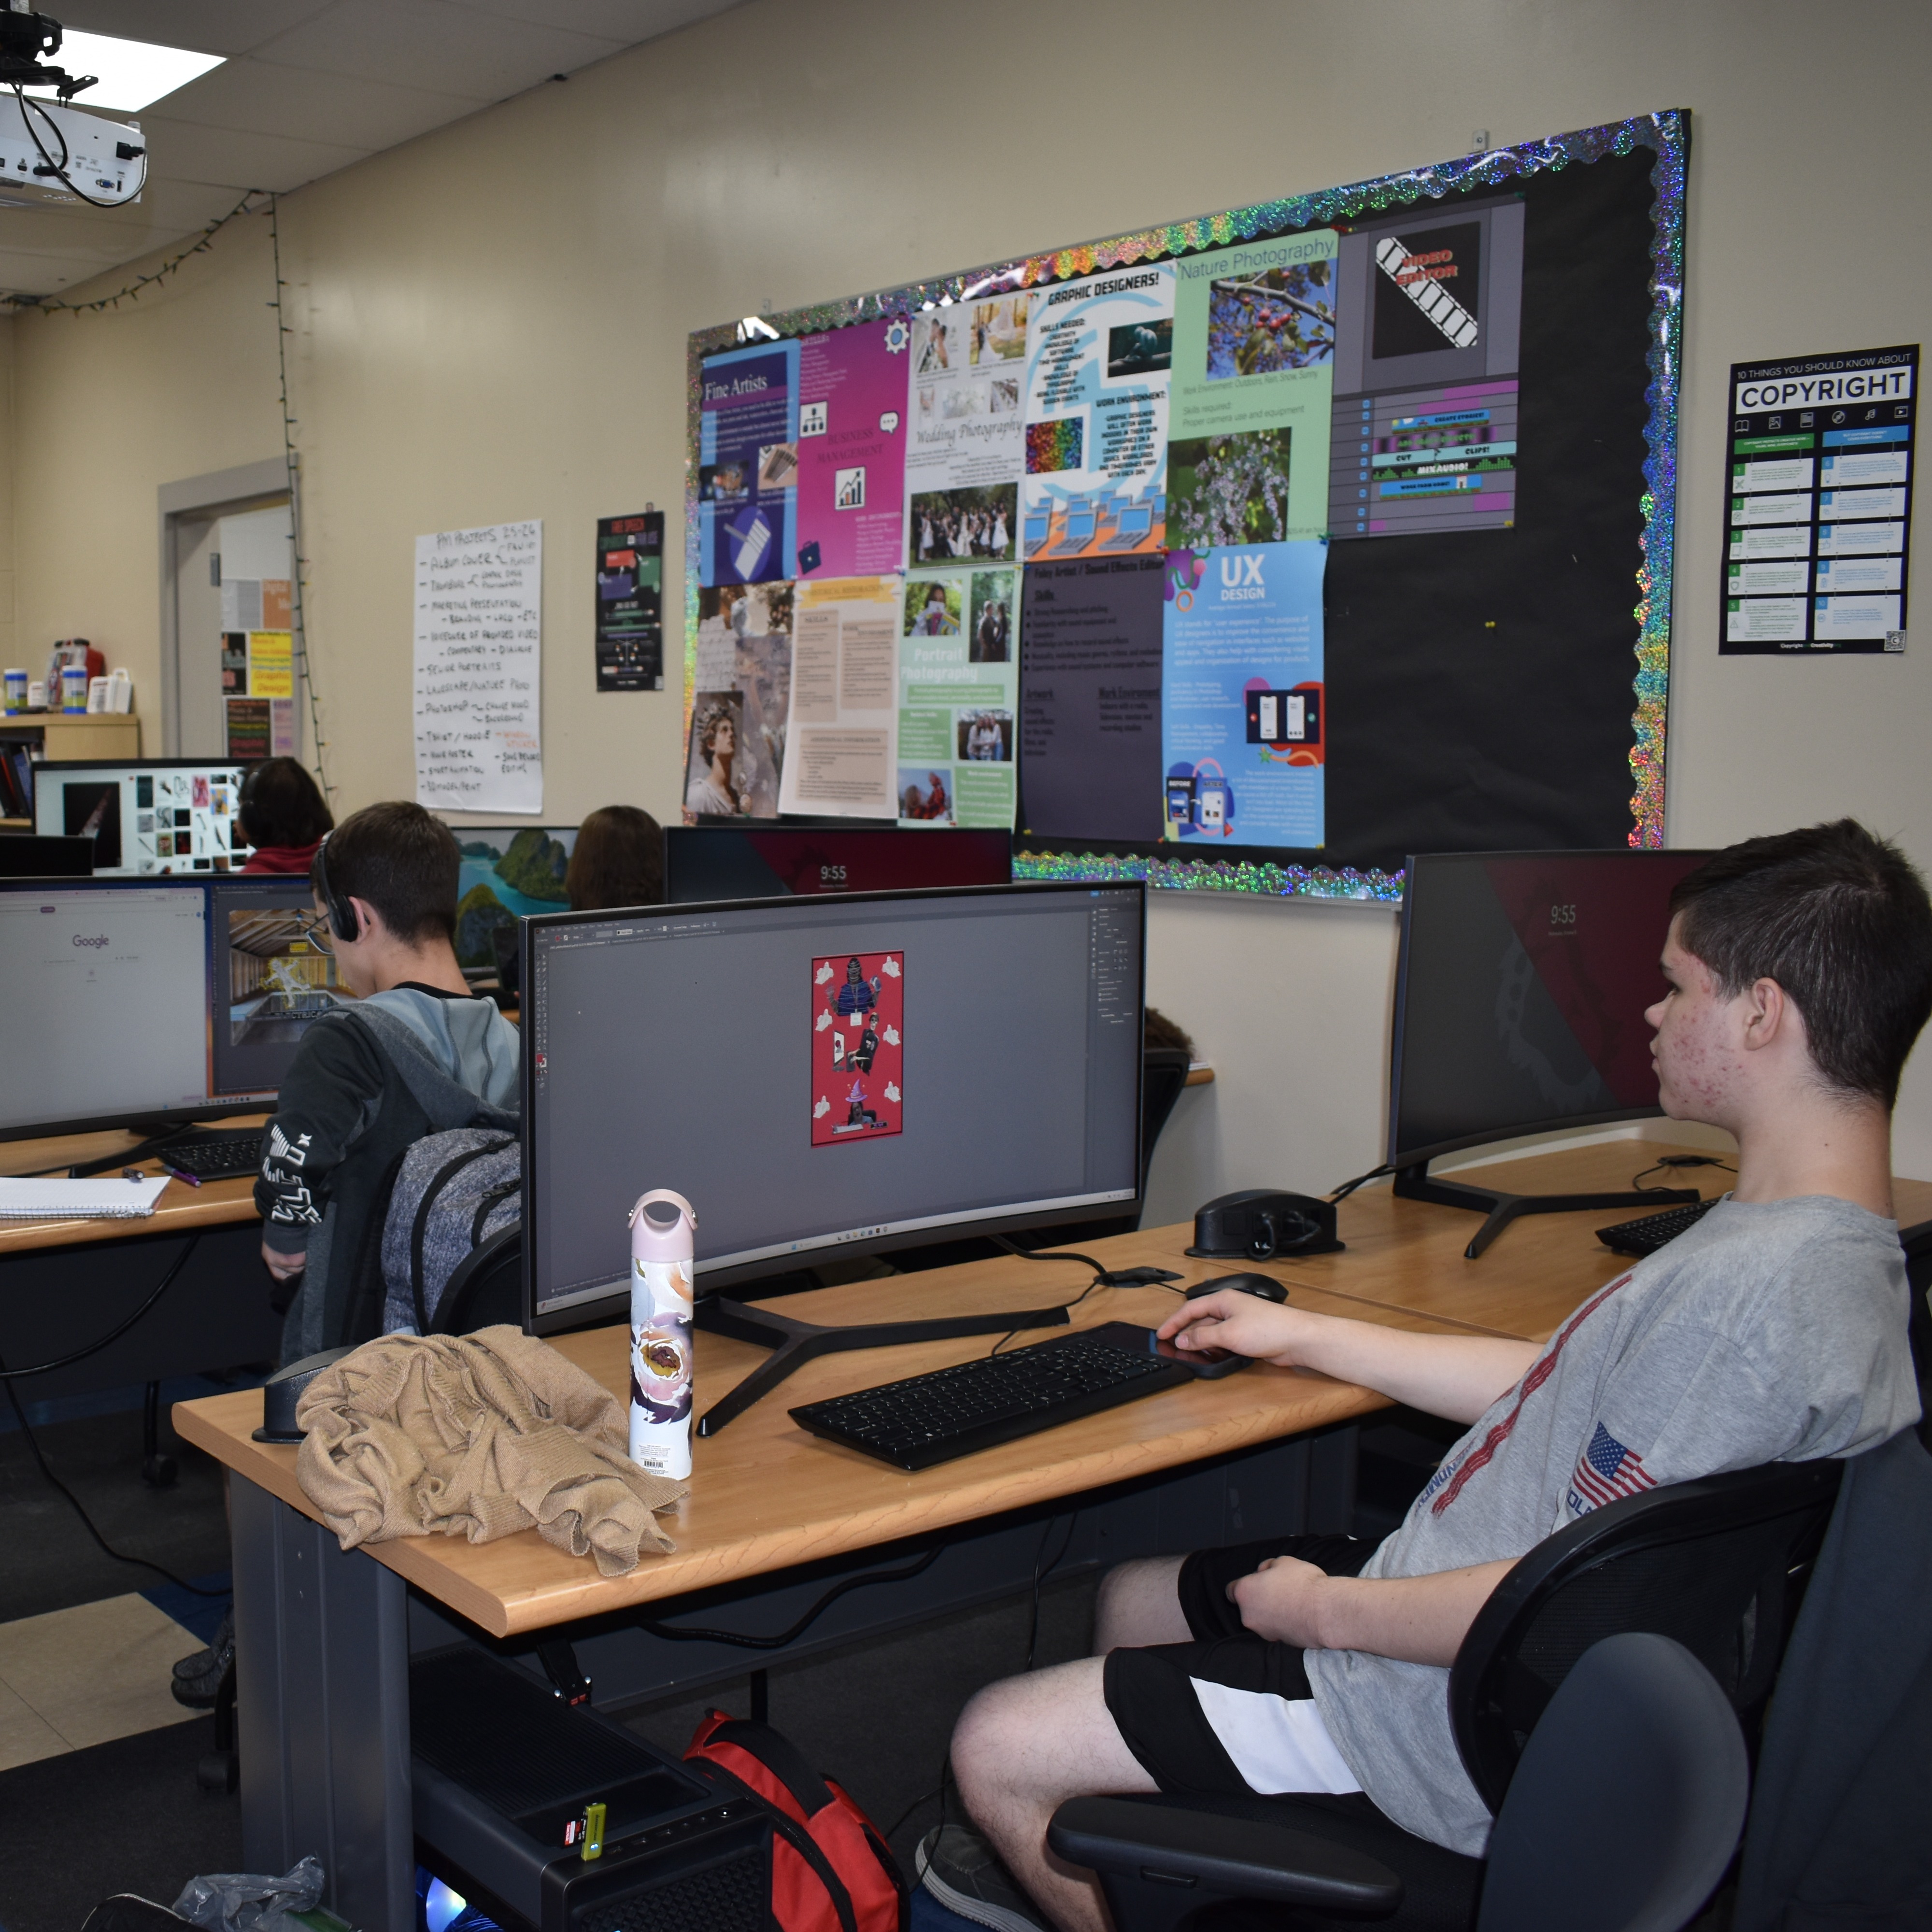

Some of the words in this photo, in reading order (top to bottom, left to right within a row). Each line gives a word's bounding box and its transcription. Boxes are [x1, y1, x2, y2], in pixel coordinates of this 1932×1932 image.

[1180, 258, 1228, 280] Nature
[1233, 238, 1335, 269] Photography
[1401, 249, 1453, 268] VIDEO
[1396, 264, 1458, 286] EDITOR
[1048, 284, 1092, 306] GRAPHIC
[1094, 272, 1159, 297] DESIGNERS!
[1040, 322, 1059, 333] SKILLS
[1737, 370, 1747, 379] 10
[1749, 367, 1781, 378] THINGS
[1783, 365, 1803, 375] YOU
[1805, 360, 1843, 372] SHOULD
[1846, 357, 1875, 368] KNOW
[1877, 353, 1911, 365] ABOUT
[705, 382, 729, 401] Fine
[731, 374, 767, 396] Artists
[1741, 372, 1905, 408] COPYRIGHT
[1264, 405, 1305, 417] equipment
[827, 428, 873, 445] BUSINESS
[917, 424, 956, 447] Wedding
[958, 413, 1023, 442] Photography
[817, 444, 884, 464] MANAGEMENT
[1465, 446, 1490, 455] CLIPS!
[1417, 466, 1435, 474] MIX
[1436, 462, 1469, 473] AUDIO!
[1221, 554, 1265, 587] UX
[1221, 587, 1265, 601] DESIGN
[914, 647, 963, 663] Portrait
[458, 661, 501, 671] PORTRAITS
[901, 666, 979, 682] Photography
[821, 866, 847, 879] 9:55
[1551, 905, 1576, 924] 9:55
[72, 934, 109, 949] Google
